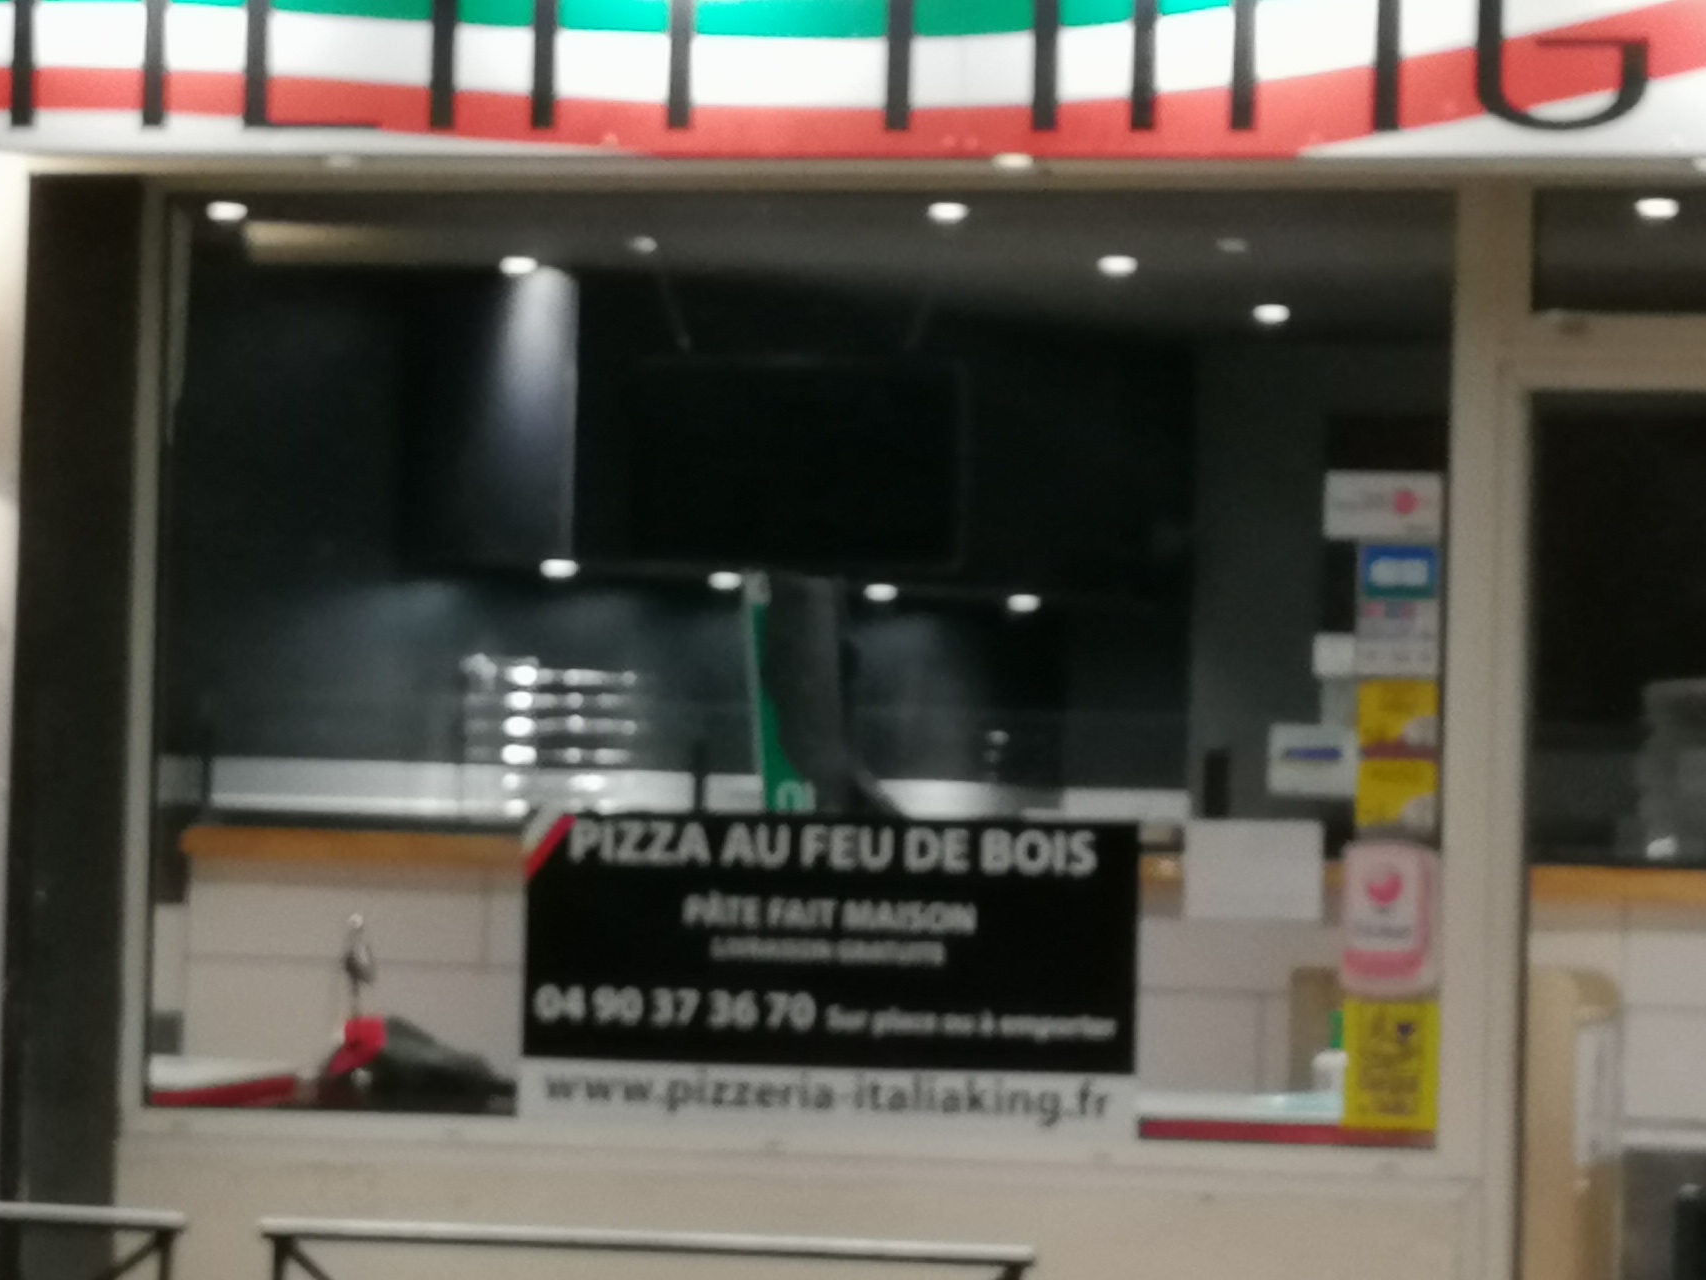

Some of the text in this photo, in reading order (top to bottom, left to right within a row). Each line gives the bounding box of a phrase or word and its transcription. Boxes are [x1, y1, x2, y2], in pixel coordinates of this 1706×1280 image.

[566, 818, 1097, 877] PIZZA AU FEU DE BOIS
[766, 896, 838, 931] FAIT
[842, 898, 978, 935] MAISON
[532, 981, 587, 1026] 04
[591, 983, 645, 1028] 90
[650, 986, 700, 1028] 37
[706, 987, 760, 1031] 36
[763, 989, 817, 1033] 70
[543, 1072, 1110, 1127] www.pizzeria-italiaking.fr
